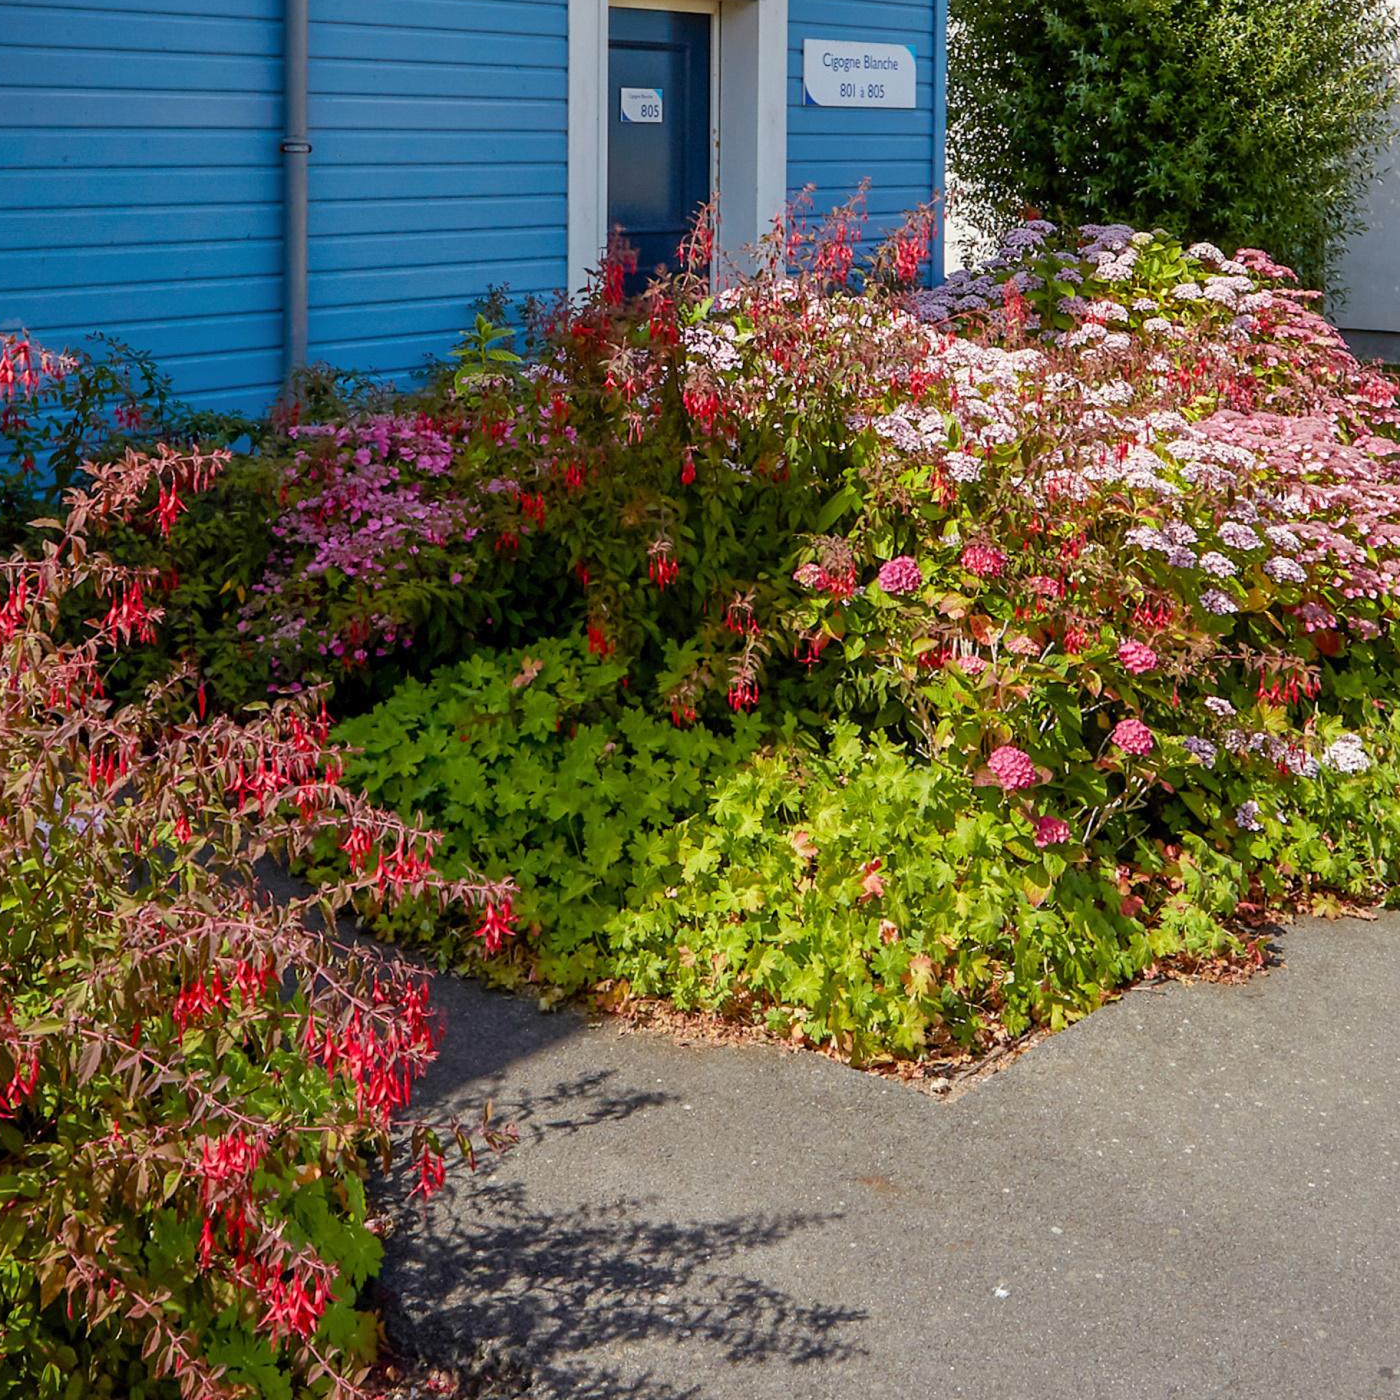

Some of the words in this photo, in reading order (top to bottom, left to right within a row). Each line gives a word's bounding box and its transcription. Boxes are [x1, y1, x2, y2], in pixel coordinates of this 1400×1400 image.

[822, 52, 861, 72] Cigogne
[864, 55, 899, 70] Blanche
[840, 83, 856, 98] 801
[867, 84, 885, 98] 805
[641, 104, 660, 118] 805
